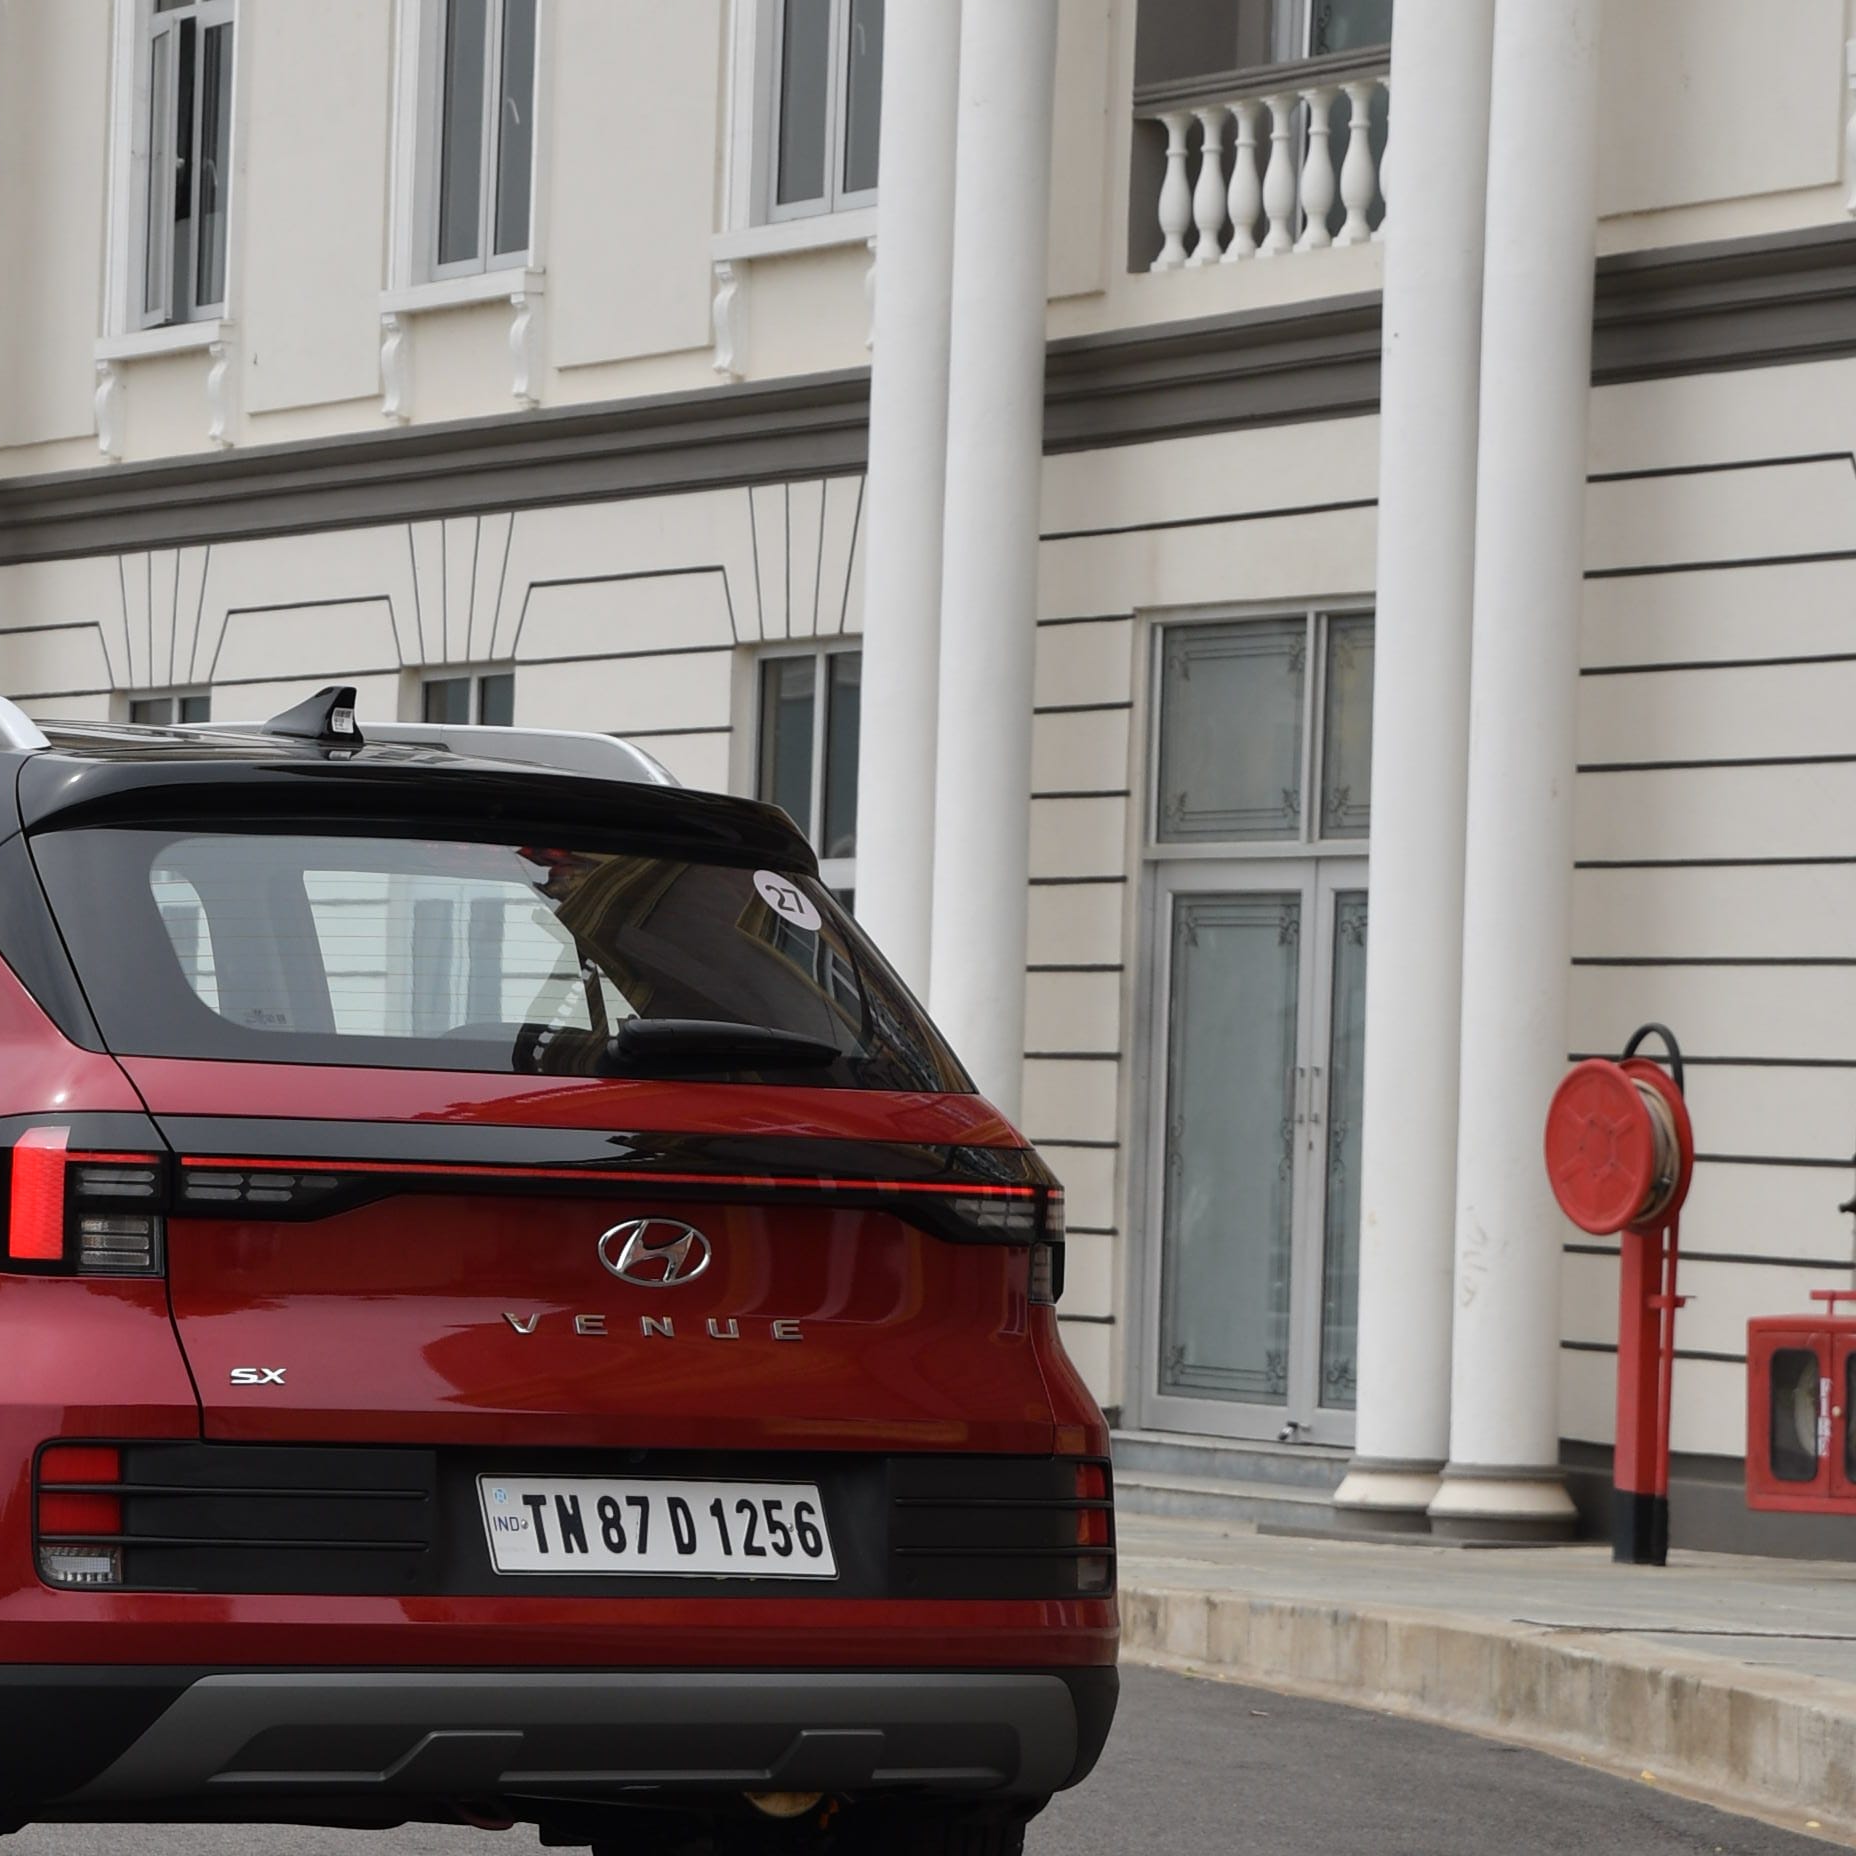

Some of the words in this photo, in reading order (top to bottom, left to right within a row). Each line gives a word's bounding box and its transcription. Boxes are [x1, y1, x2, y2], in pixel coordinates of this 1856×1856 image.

[765, 885, 804, 914] 27
[501, 1312, 804, 1340] VENUE
[230, 1367, 287, 1385] SX
[492, 1515, 520, 1532] IND
[522, 1494, 589, 1554] TN
[597, 1495, 650, 1555] 87
[667, 1496, 697, 1555] D
[710, 1497, 824, 1558] 1256
